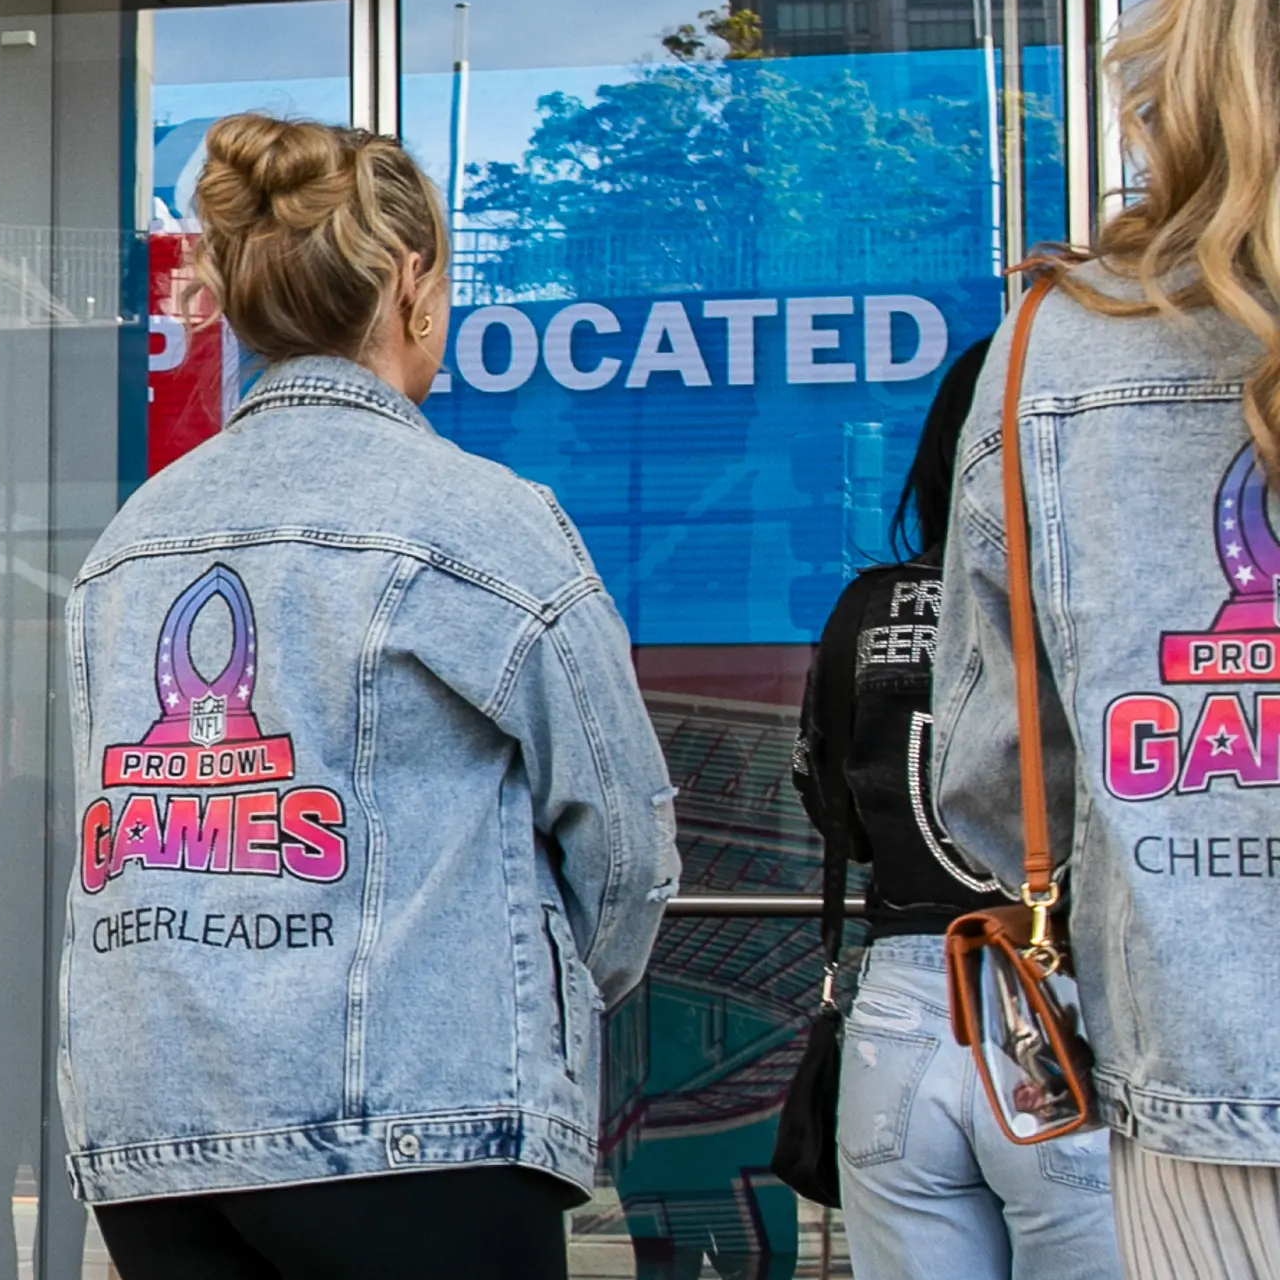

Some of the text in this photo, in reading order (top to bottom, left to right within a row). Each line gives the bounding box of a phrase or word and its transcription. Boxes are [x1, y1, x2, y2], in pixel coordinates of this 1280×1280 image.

[429, 294, 949, 394] OCATED
[1190, 641, 1274, 675] PRO
[196, 716, 222, 736] NFL
[121, 746, 275, 779] PRO BOWL
[80, 784, 348, 895] GAMES
[92, 906, 335, 954] CHEERLEADER
